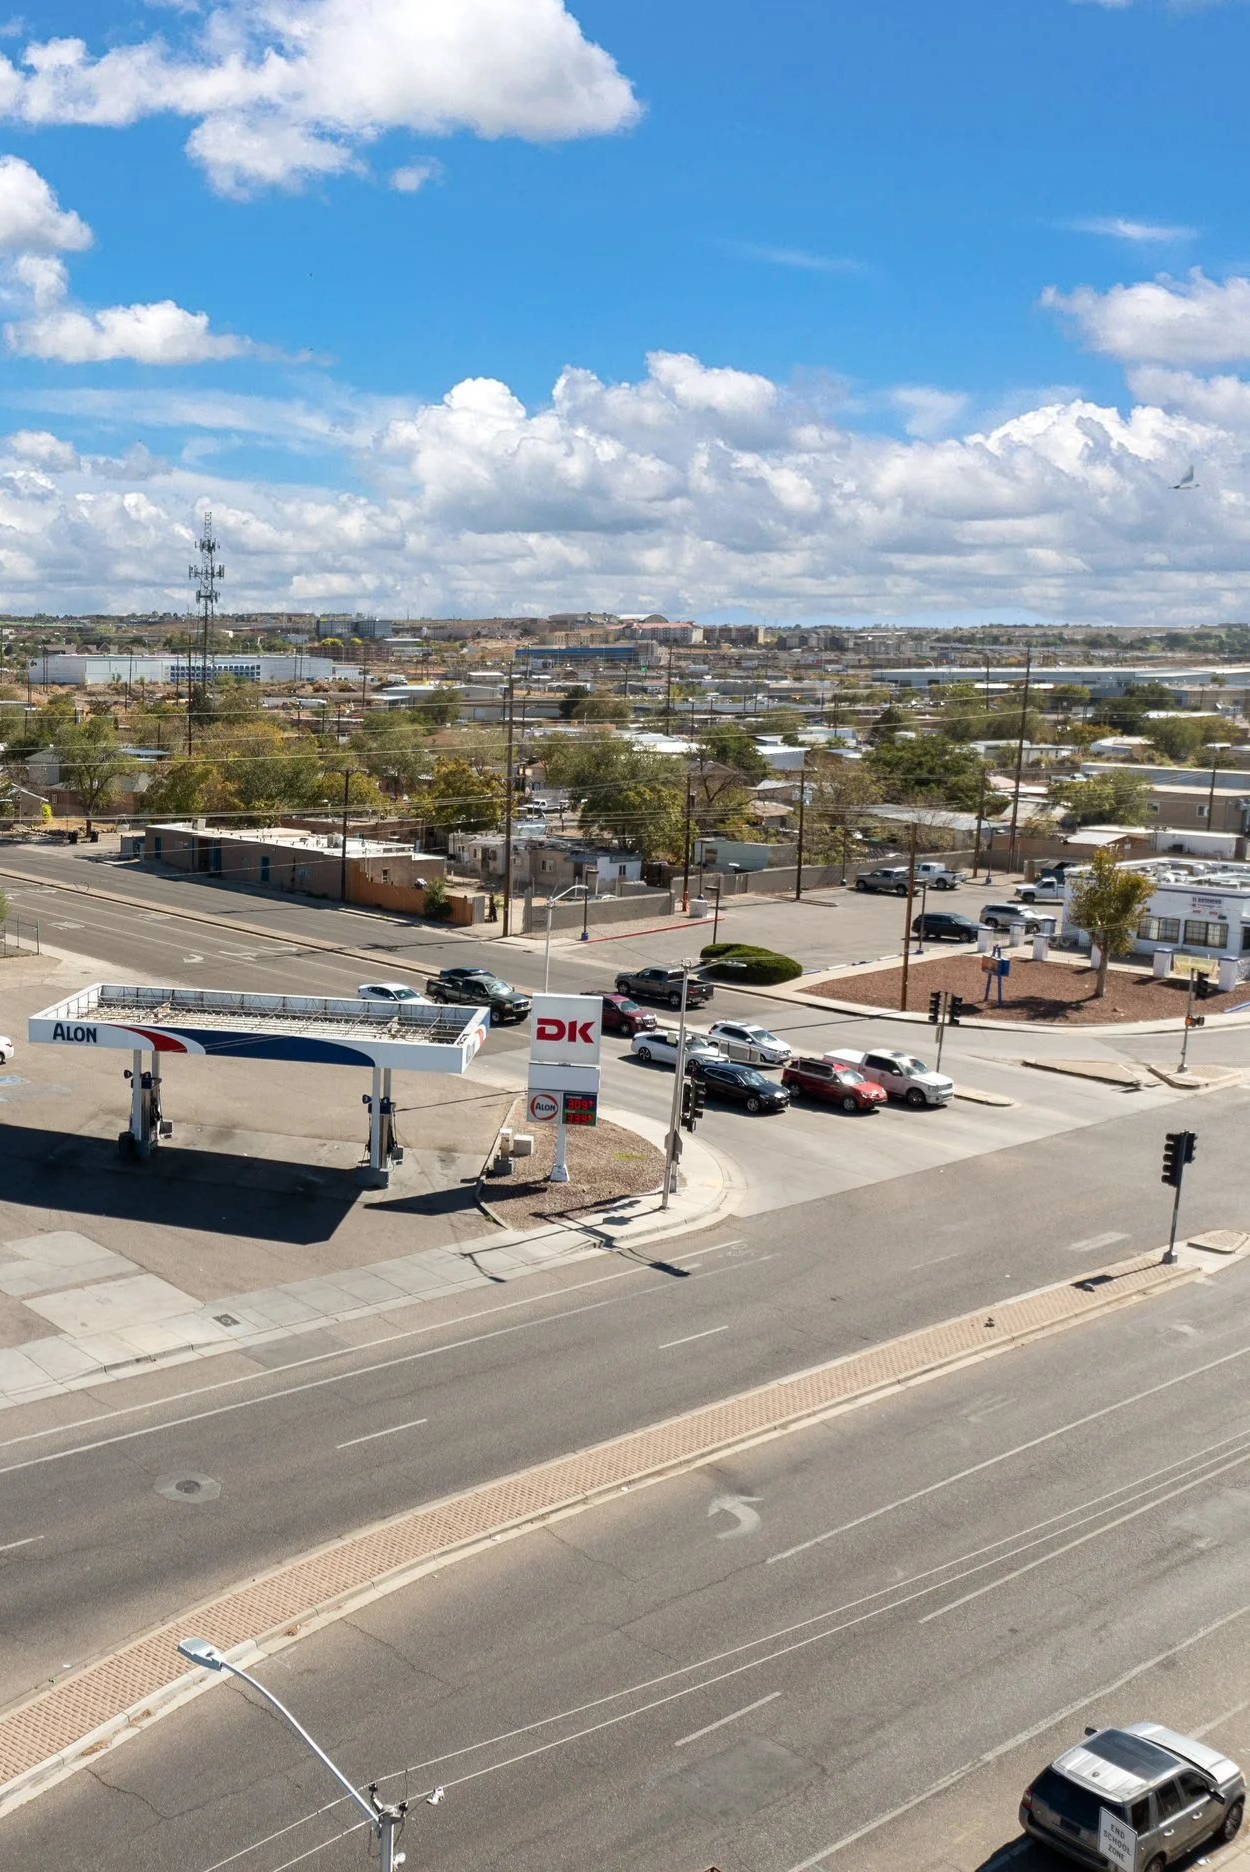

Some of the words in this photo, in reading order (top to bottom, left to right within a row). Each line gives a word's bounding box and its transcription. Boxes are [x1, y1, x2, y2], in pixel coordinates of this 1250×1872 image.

[53, 1022, 97, 1043] ALON
[536, 1018, 595, 1044] DK
[535, 1102, 556, 1112] ALON
[1110, 1823, 1125, 1840] END
[1103, 1829, 1133, 1857] SCHOOL
[1108, 1844, 1126, 1863] ZONE
